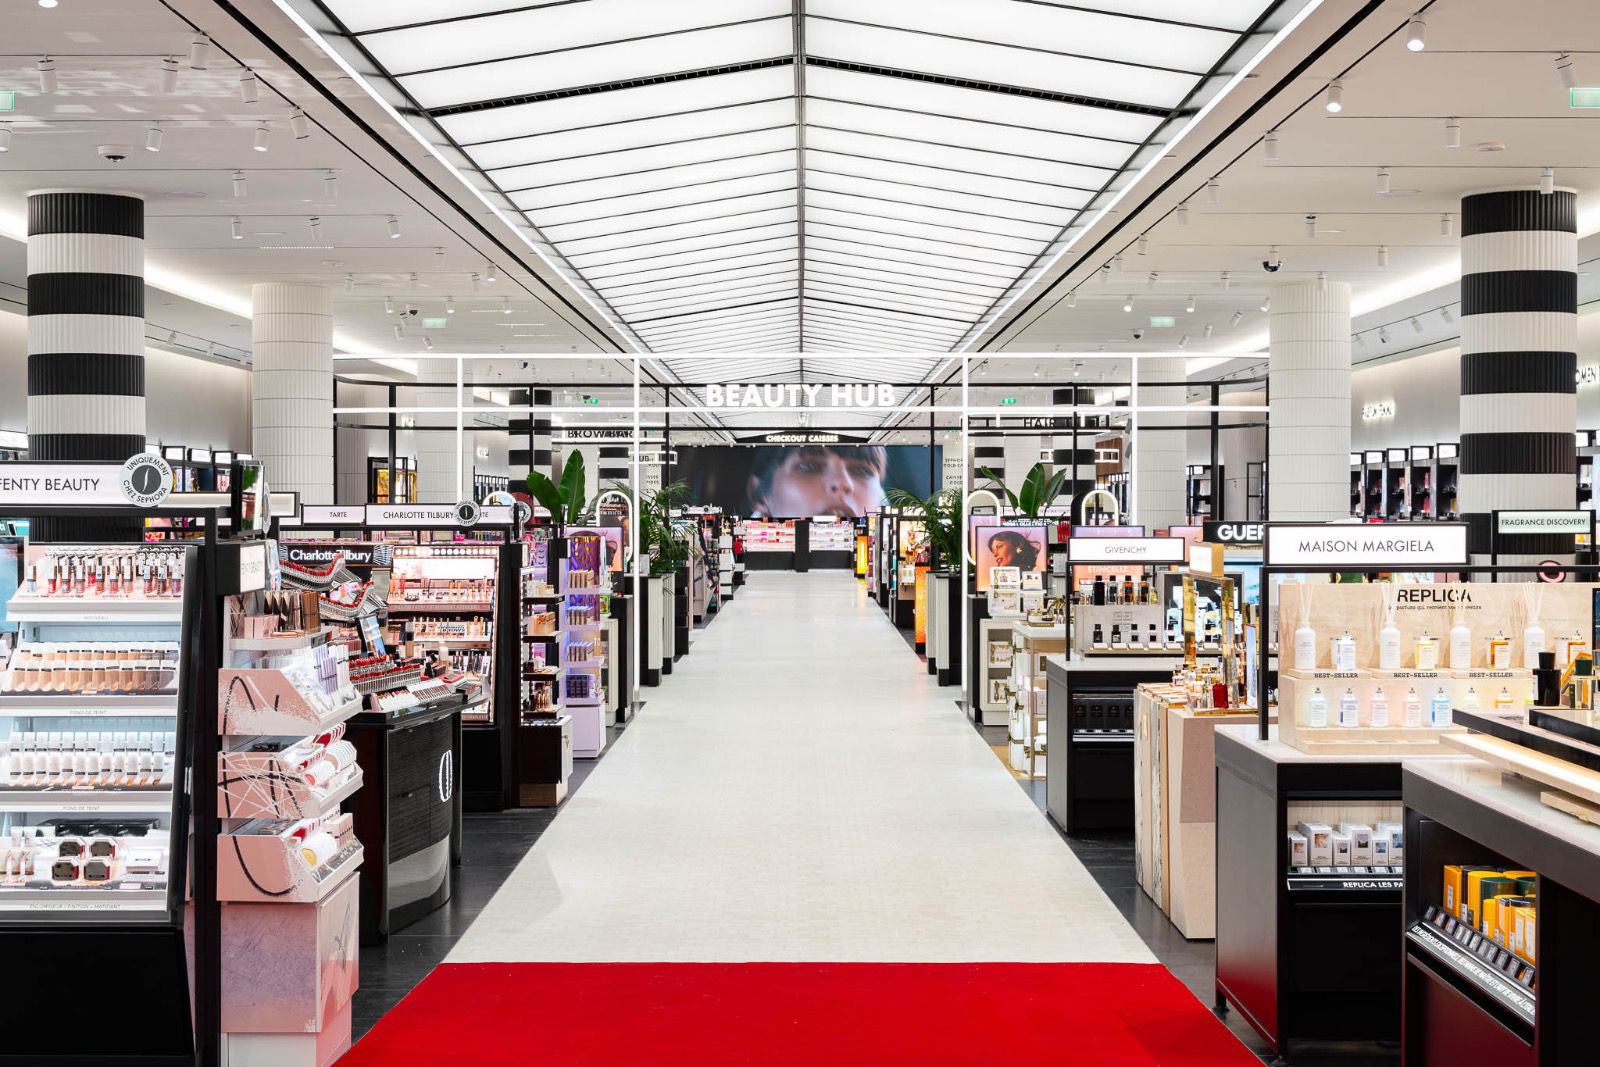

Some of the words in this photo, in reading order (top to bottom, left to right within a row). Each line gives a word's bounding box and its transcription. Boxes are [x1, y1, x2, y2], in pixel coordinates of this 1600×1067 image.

[706, 384, 823, 407] BEAUTY
[831, 384, 896, 407] HUB
[567, 430, 606, 438] BROW
[766, 434, 807, 443] CHECKOUT
[808, 434, 839, 443] CAISSES
[127, 456, 170, 476] UNIQUEMENT
[45, 478, 100, 491] BEAUTY
[123, 480, 137, 499] CHEZ
[136, 487, 168, 503] SEPHORA
[383, 511, 425, 519] CHARLOTTE
[426, 511, 454, 519] TILBURY
[1104, 546, 1147, 554] GIVENCHY
[1299, 540, 1358, 552] MAISON
[1362, 540, 1435, 552] MARGIELA
[290, 549, 337, 560] Charlotte
[1397, 589, 1472, 602] REPLICA
